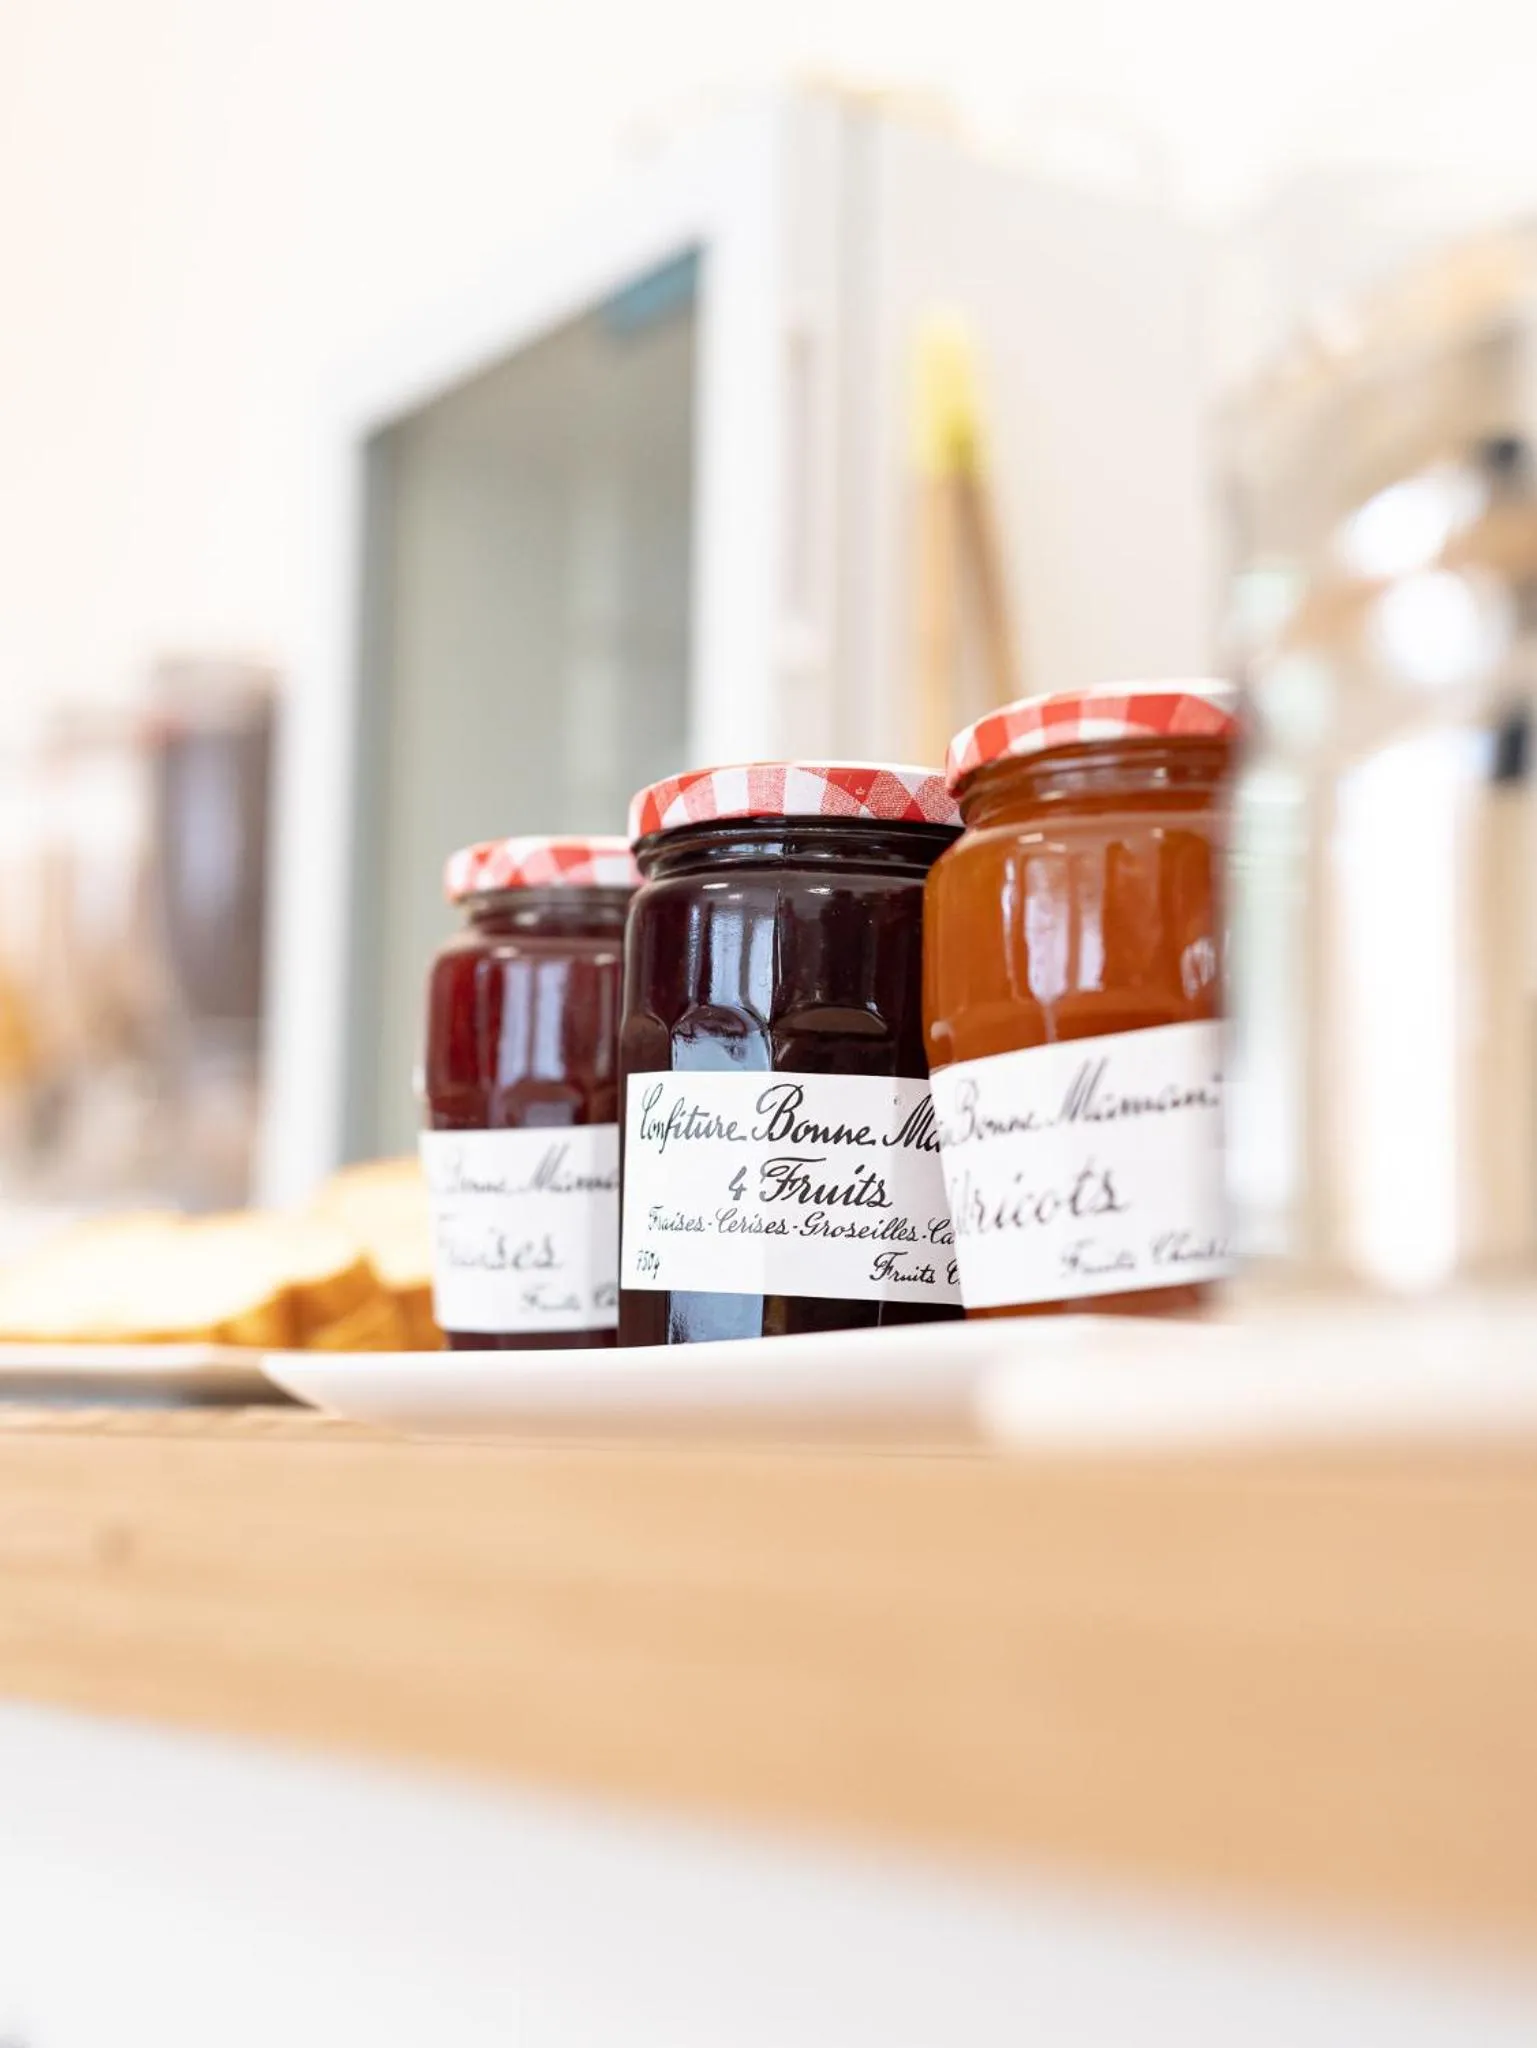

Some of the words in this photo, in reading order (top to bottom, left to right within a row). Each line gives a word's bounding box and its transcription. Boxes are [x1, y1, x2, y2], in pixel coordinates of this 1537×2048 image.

[639, 1082, 747, 1154] Confiture
[752, 1083, 876, 1147] Bonne
[728, 1166, 747, 1201] 4
[759, 1157, 893, 1207] Fruits
[869, 1251, 936, 1284] Fruits
